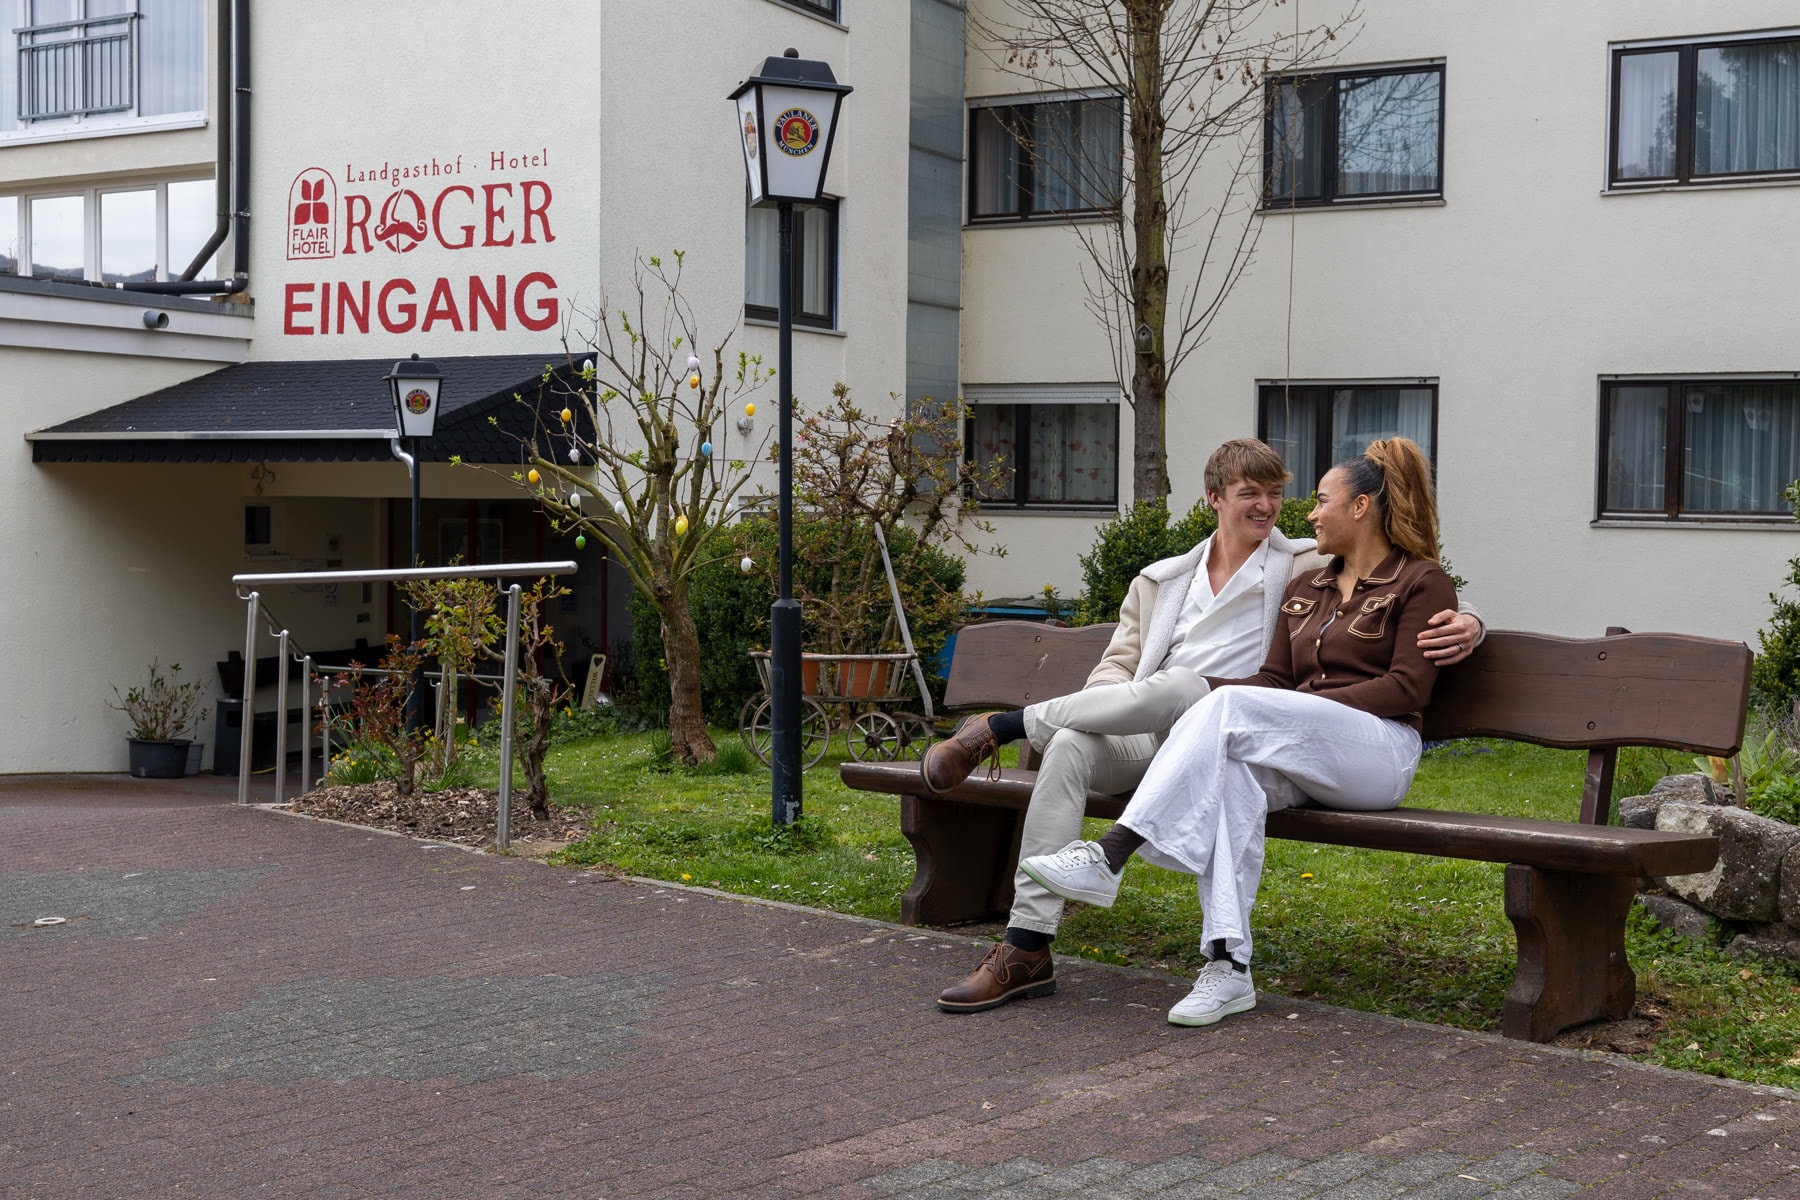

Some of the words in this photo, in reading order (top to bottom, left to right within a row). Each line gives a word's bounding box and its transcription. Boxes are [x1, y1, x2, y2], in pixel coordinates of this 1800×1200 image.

[777, 110, 818, 131] PAULANER
[346, 154, 462, 187] Landgasthof
[490, 147, 548, 171] Hotel
[342, 180, 556, 254] ROGER
[292, 227, 329, 241] FLAIR
[292, 241, 330, 254] HOTEL
[284, 271, 559, 335] EINGANG
